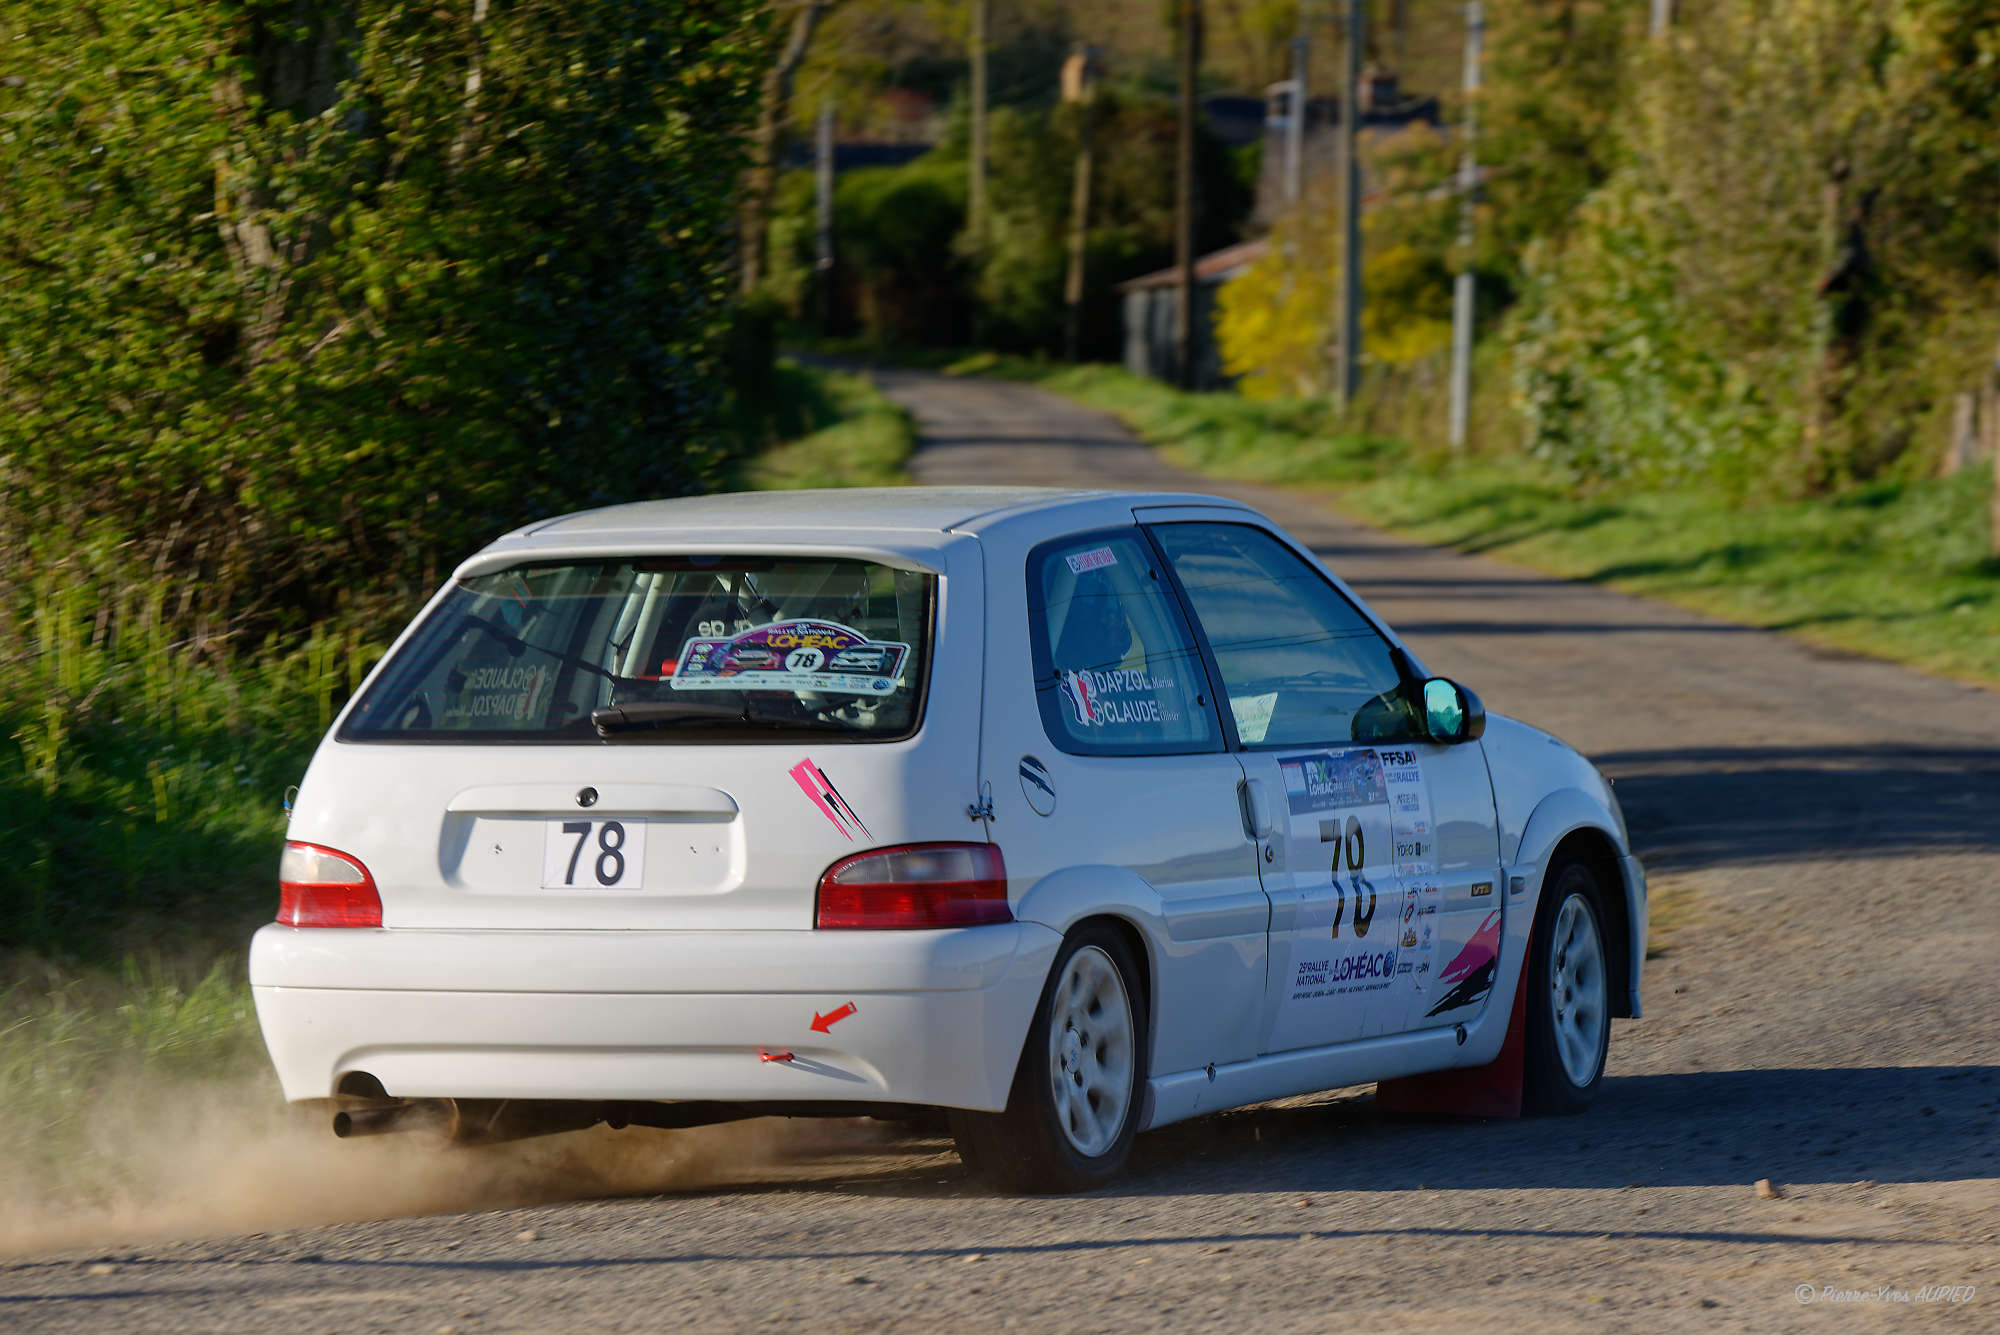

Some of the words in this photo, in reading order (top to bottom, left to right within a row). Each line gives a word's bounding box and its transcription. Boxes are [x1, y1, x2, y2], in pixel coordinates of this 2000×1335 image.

[792, 653, 817, 668] 78
[1094, 670, 1152, 694] DAPZOL
[1104, 700, 1161, 722] CLAUDE
[1381, 751, 1413, 767] FFSA
[563, 821, 625, 886] 78
[1318, 815, 1377, 939] 78
[1332, 952, 1383, 982] LOHÉAC
[1296, 973, 1327, 987] NATIONAL
